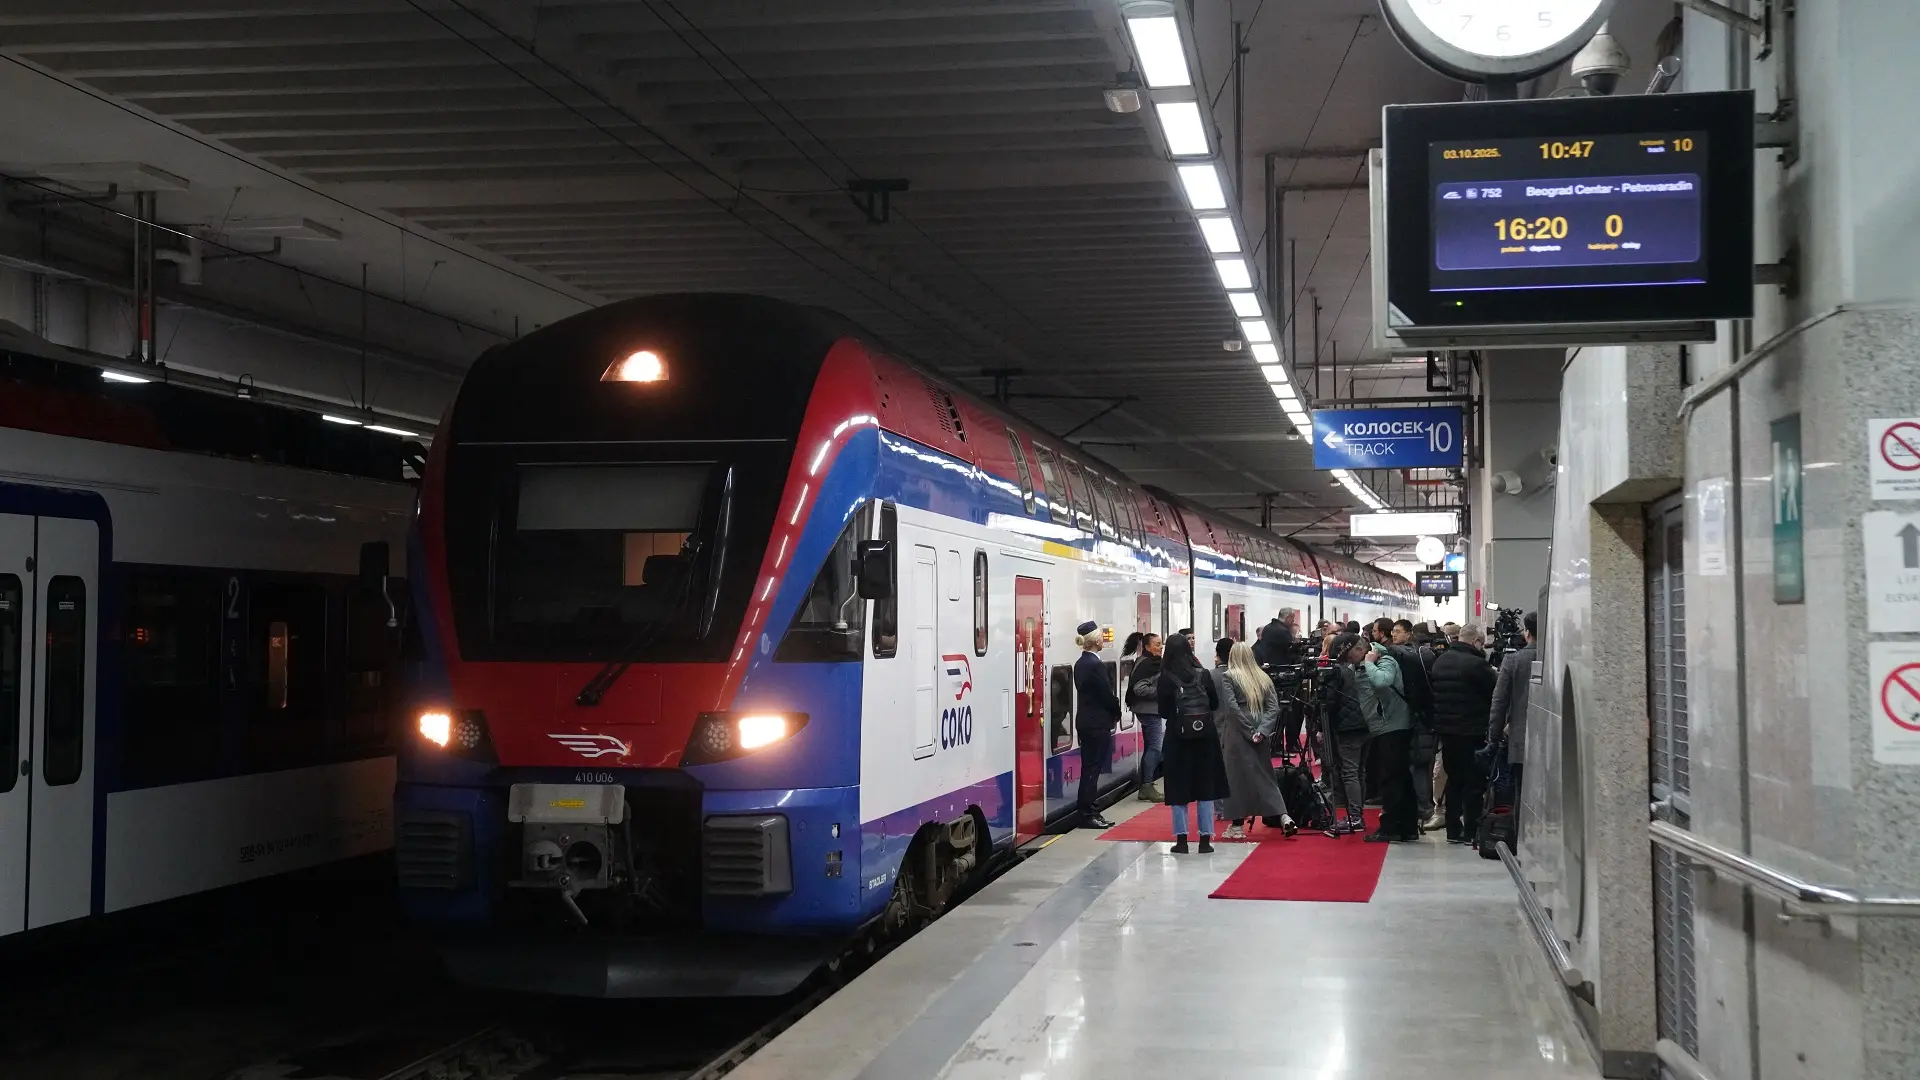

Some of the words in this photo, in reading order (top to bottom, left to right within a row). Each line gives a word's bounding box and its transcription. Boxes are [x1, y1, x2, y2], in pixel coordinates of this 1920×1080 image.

[1459, 15, 1474, 31] 7
[1538, 11, 1552, 28] 5
[1496, 25, 1511, 41] 6
[1539, 141, 1594, 159] 10:47
[1673, 138, 1693, 152] 10
[1480, 187, 1502, 198] 752
[1526, 185, 1573, 198] Beograd
[1574, 184, 1613, 195] Centar
[1621, 181, 1693, 193] Petrovaradin
[1494, 216, 1568, 241] 16:20
[1605, 214, 1623, 237] 0
[1344, 421, 1424, 436] КОЛОСЕК
[1425, 421, 1453, 453] 10
[1344, 442, 1395, 456] TRACK
[228, 576, 240, 619] 2
[1885, 592, 1920, 603] ELEVA
[941, 705, 973, 750] СОКО
[575, 772, 593, 783] 410
[595, 772, 613, 783] 006
